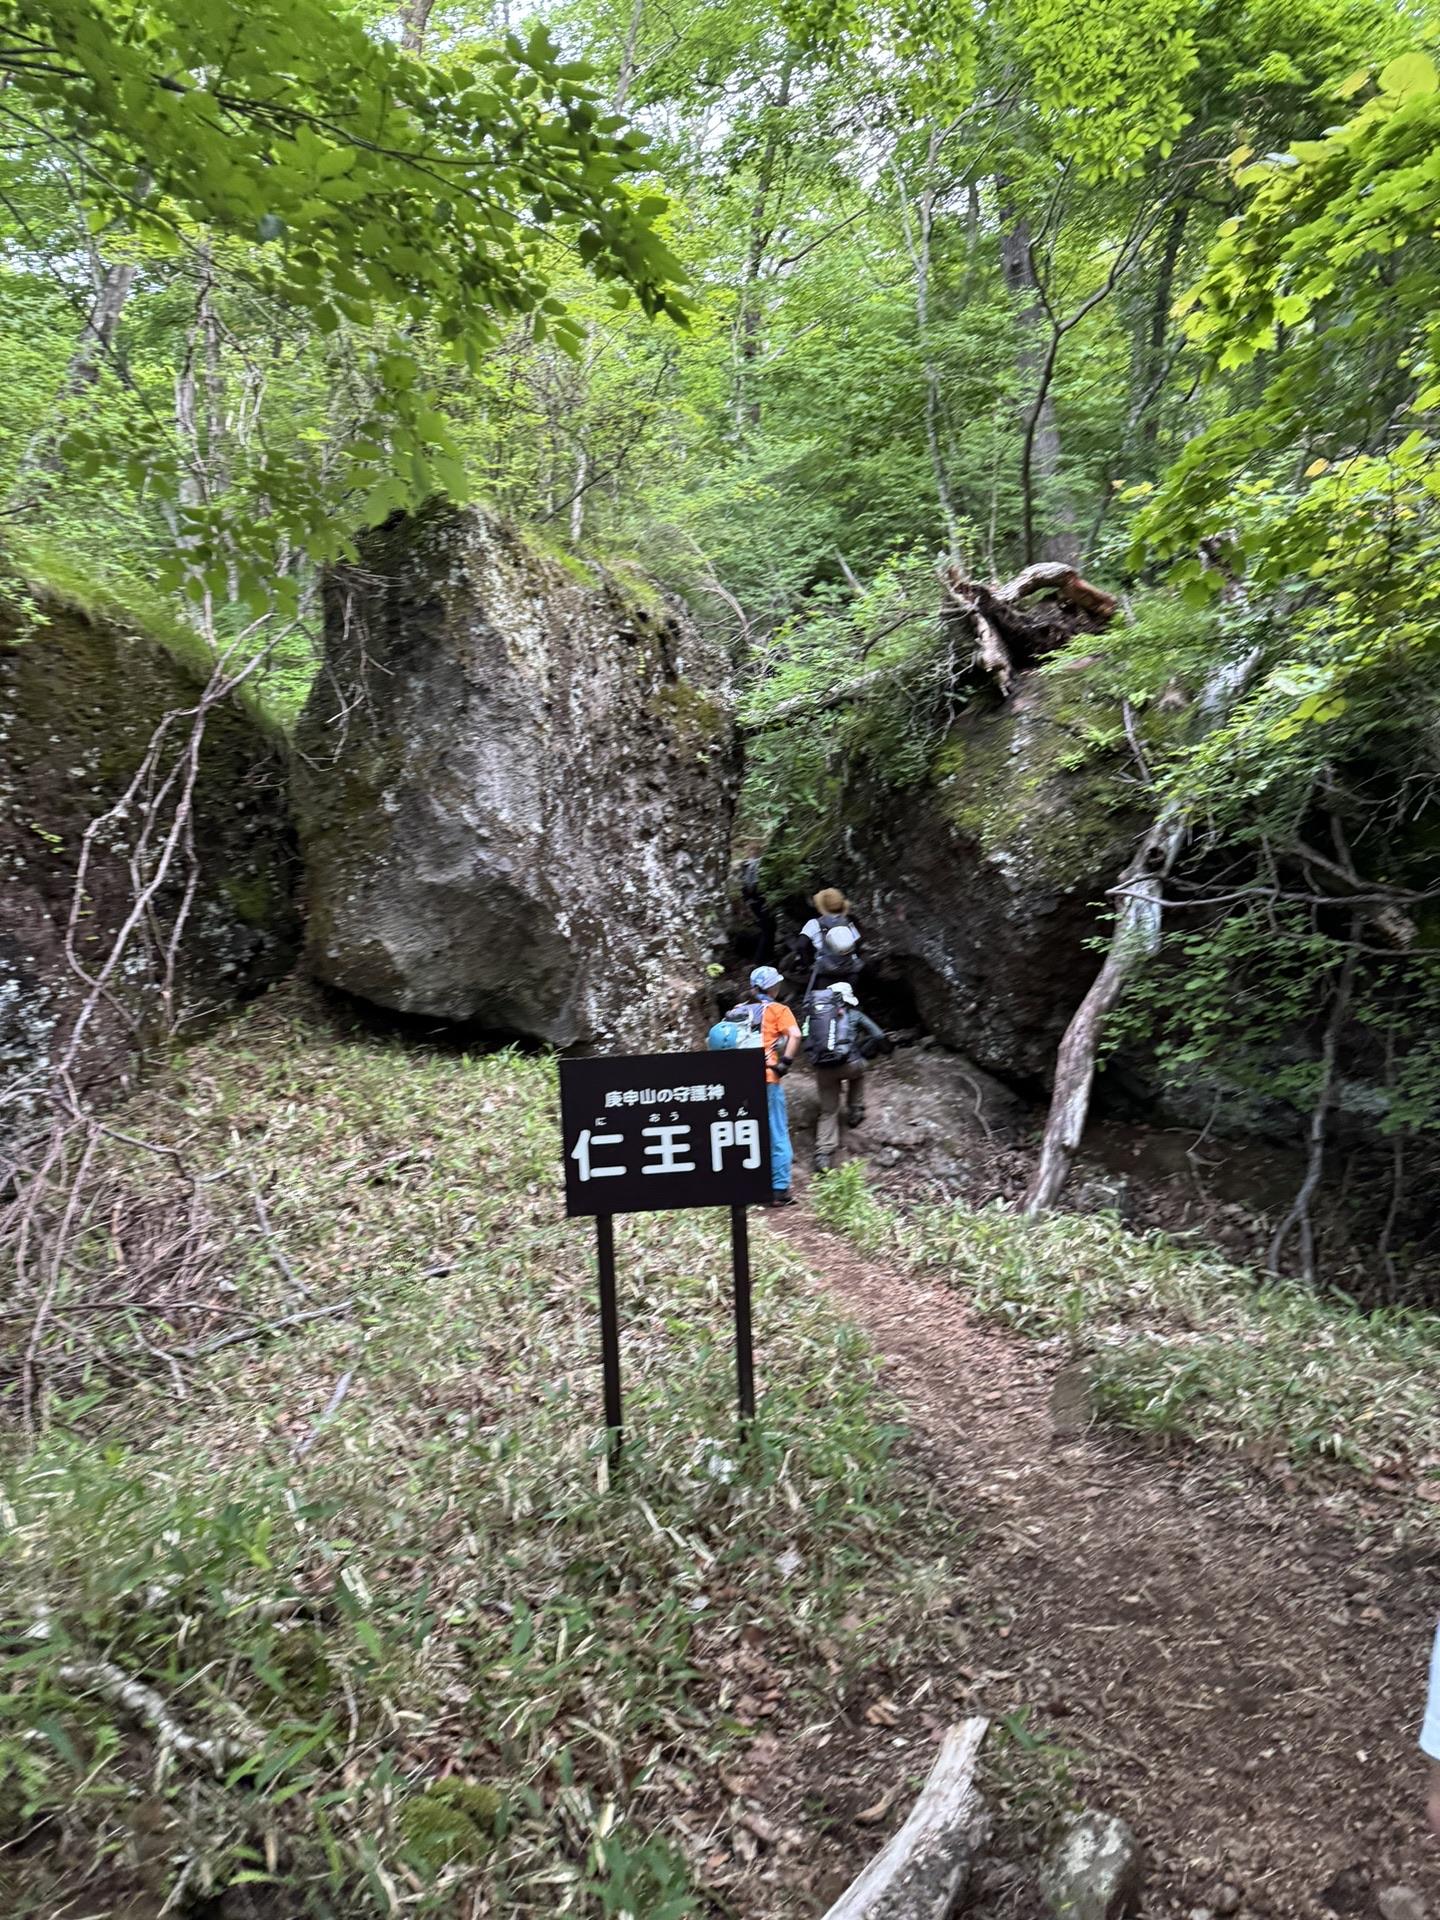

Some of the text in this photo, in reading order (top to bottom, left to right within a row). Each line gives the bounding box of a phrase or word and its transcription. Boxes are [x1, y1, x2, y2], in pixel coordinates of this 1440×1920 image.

[604, 1084, 725, 1108] 庚申山の守護神
[570, 1119, 762, 1182] 仁王門
